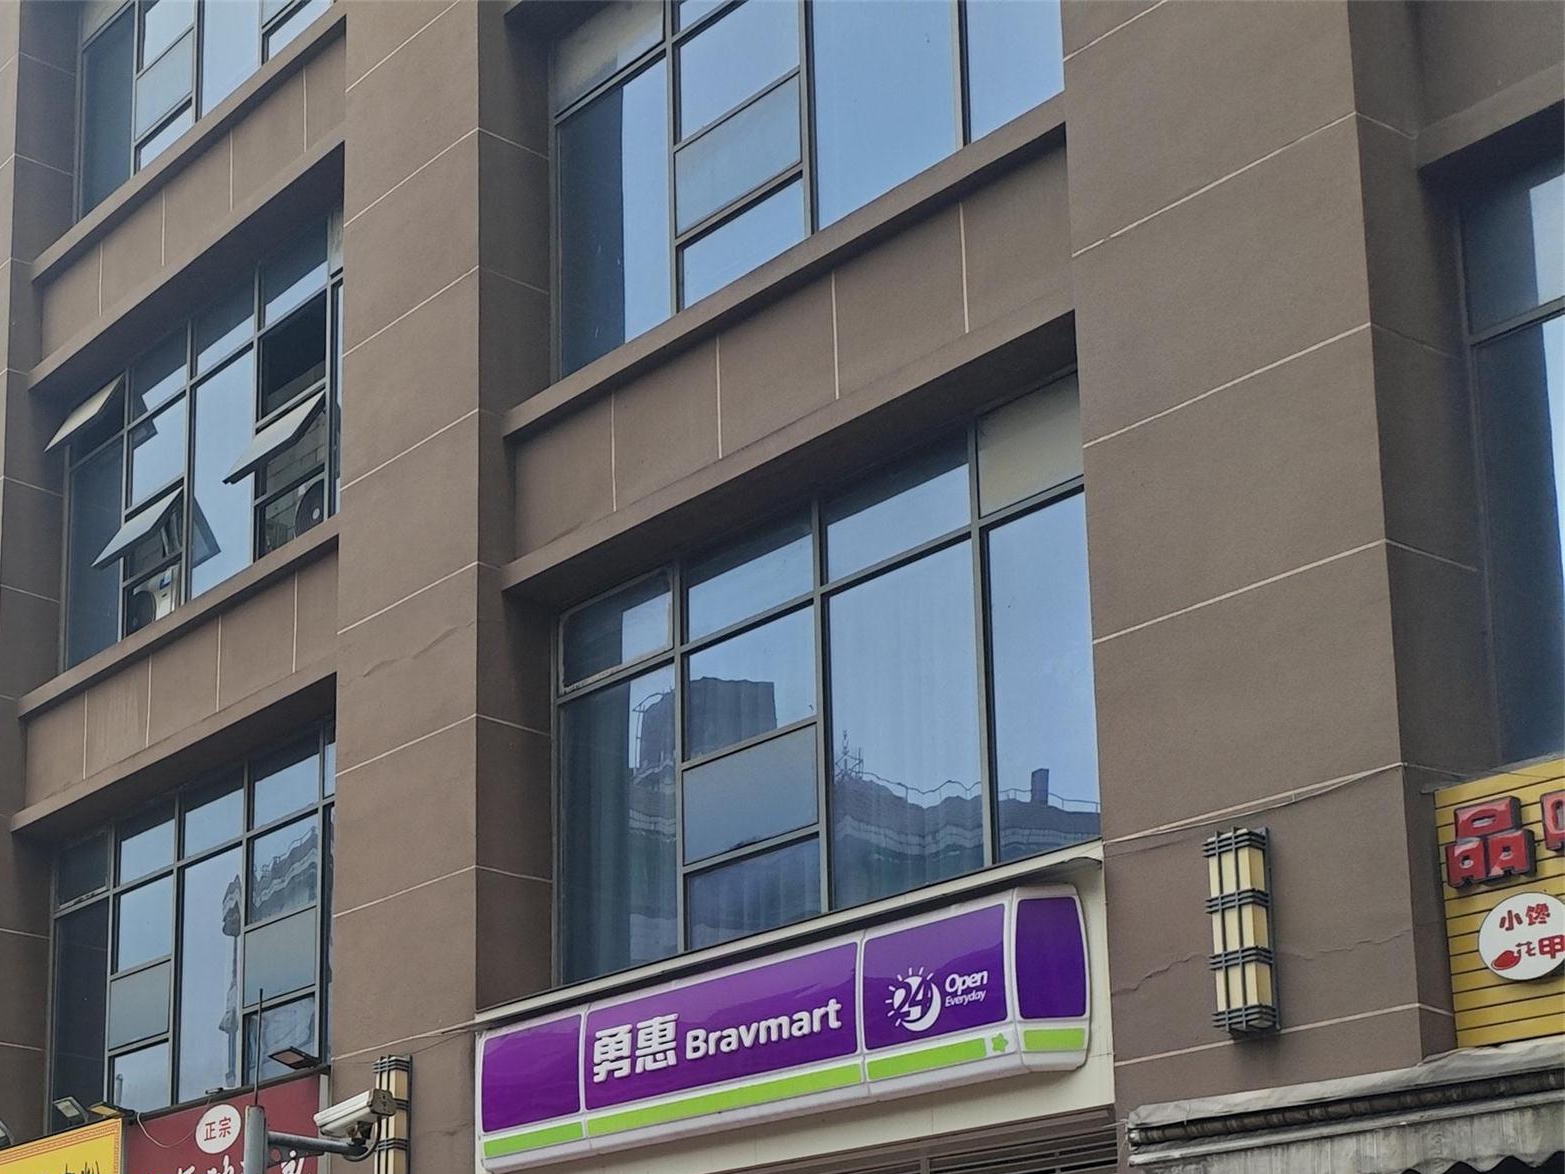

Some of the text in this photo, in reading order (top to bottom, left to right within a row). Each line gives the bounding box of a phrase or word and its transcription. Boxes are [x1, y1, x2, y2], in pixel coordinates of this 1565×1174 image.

[944, 967, 988, 994] Open
[944, 988, 986, 1009] Everyday
[592, 998, 843, 1084] 勇惠 Bravmart
[203, 1116, 232, 1142] 正宗
